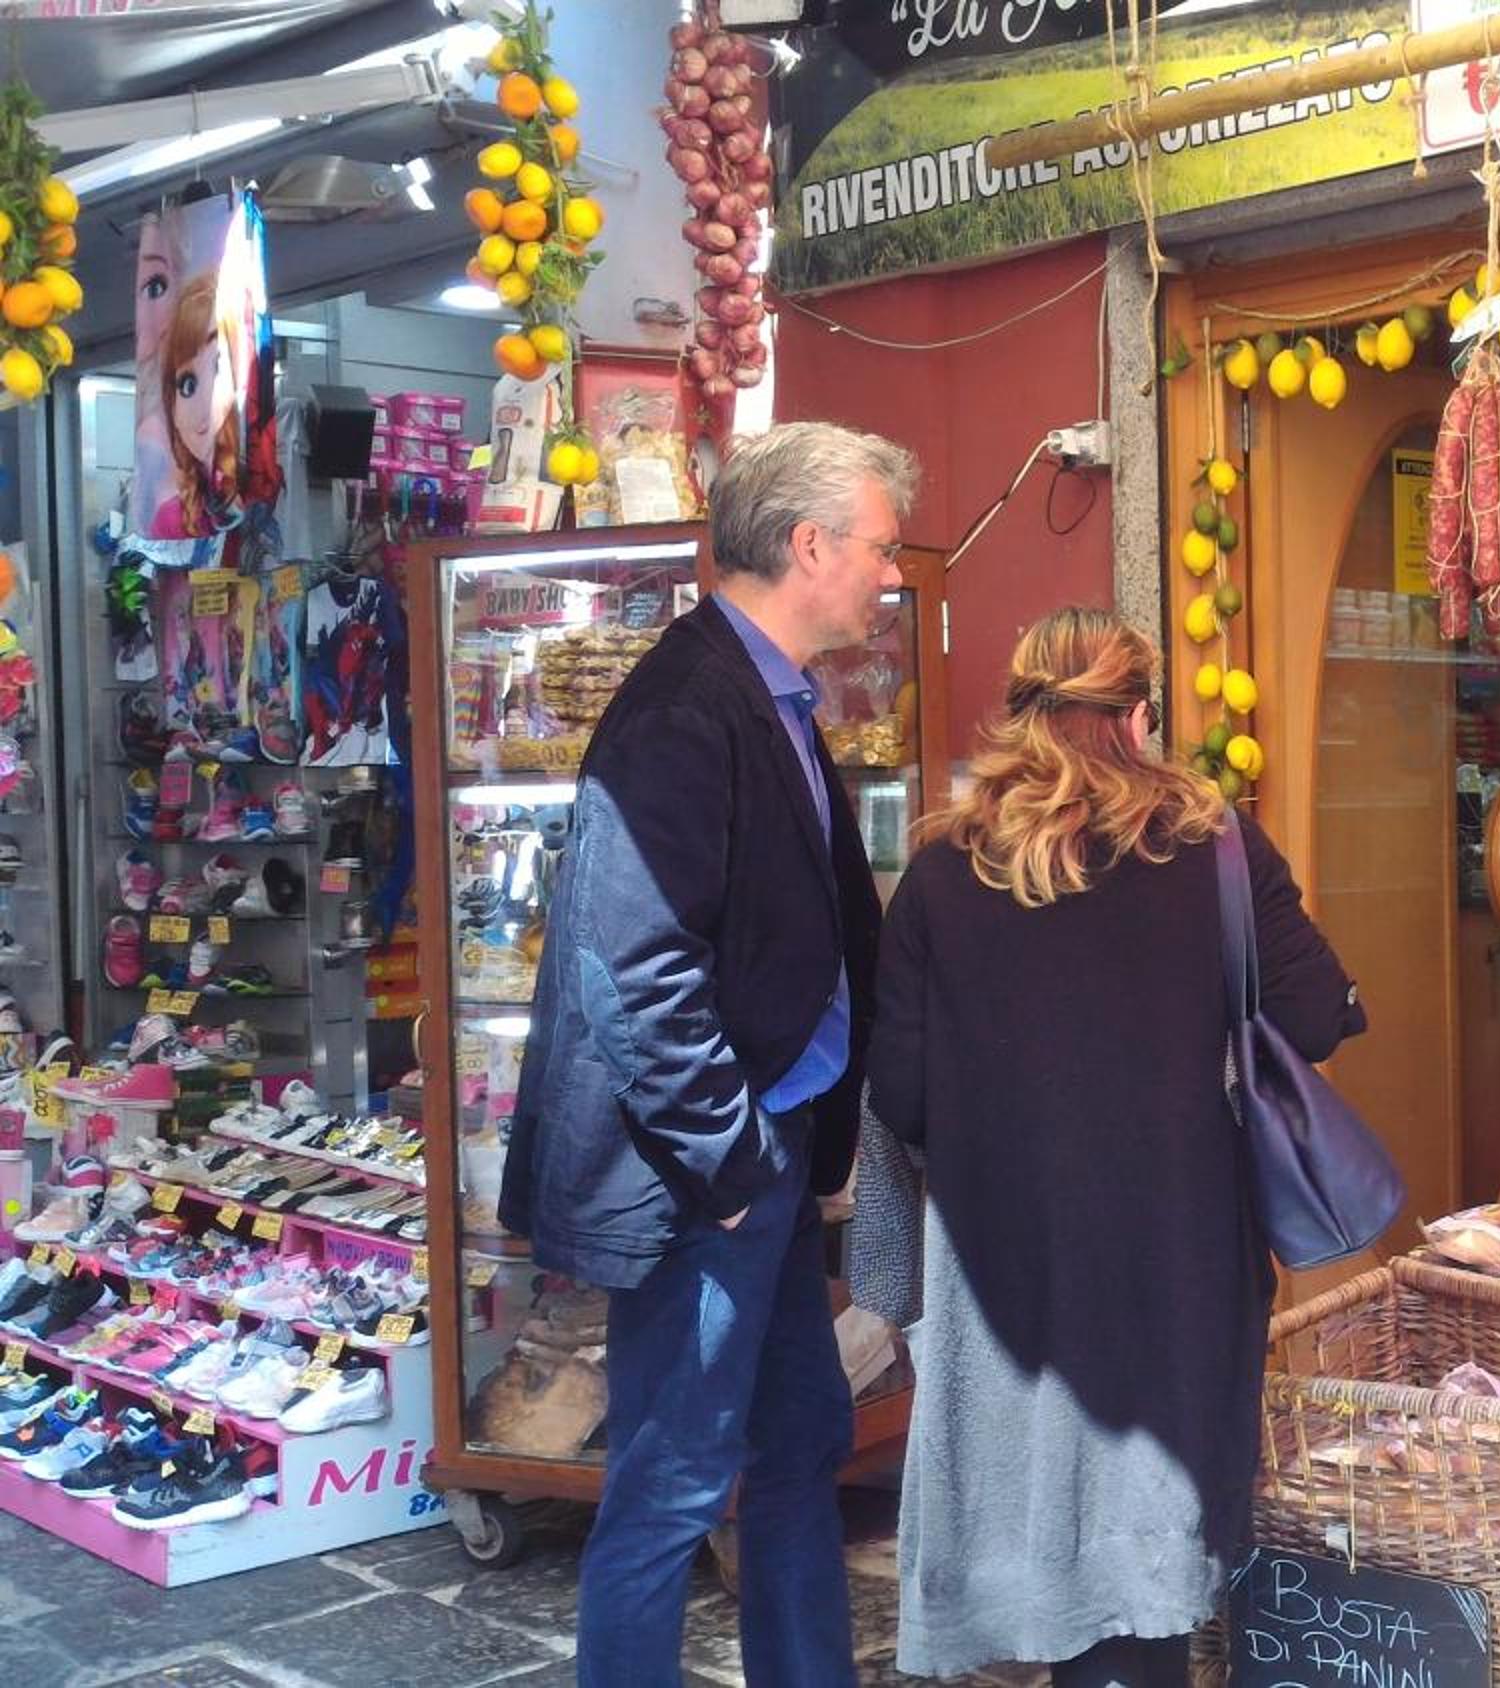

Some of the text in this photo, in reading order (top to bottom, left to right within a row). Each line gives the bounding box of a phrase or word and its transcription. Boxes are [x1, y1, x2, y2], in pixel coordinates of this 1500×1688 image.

[1072, 30, 1396, 176] AUORIZZATO
[307, 1439, 436, 1507] Mi
[1244, 1628, 1291, 1662] DI
[1258, 1559, 1431, 1652] BUSTA
